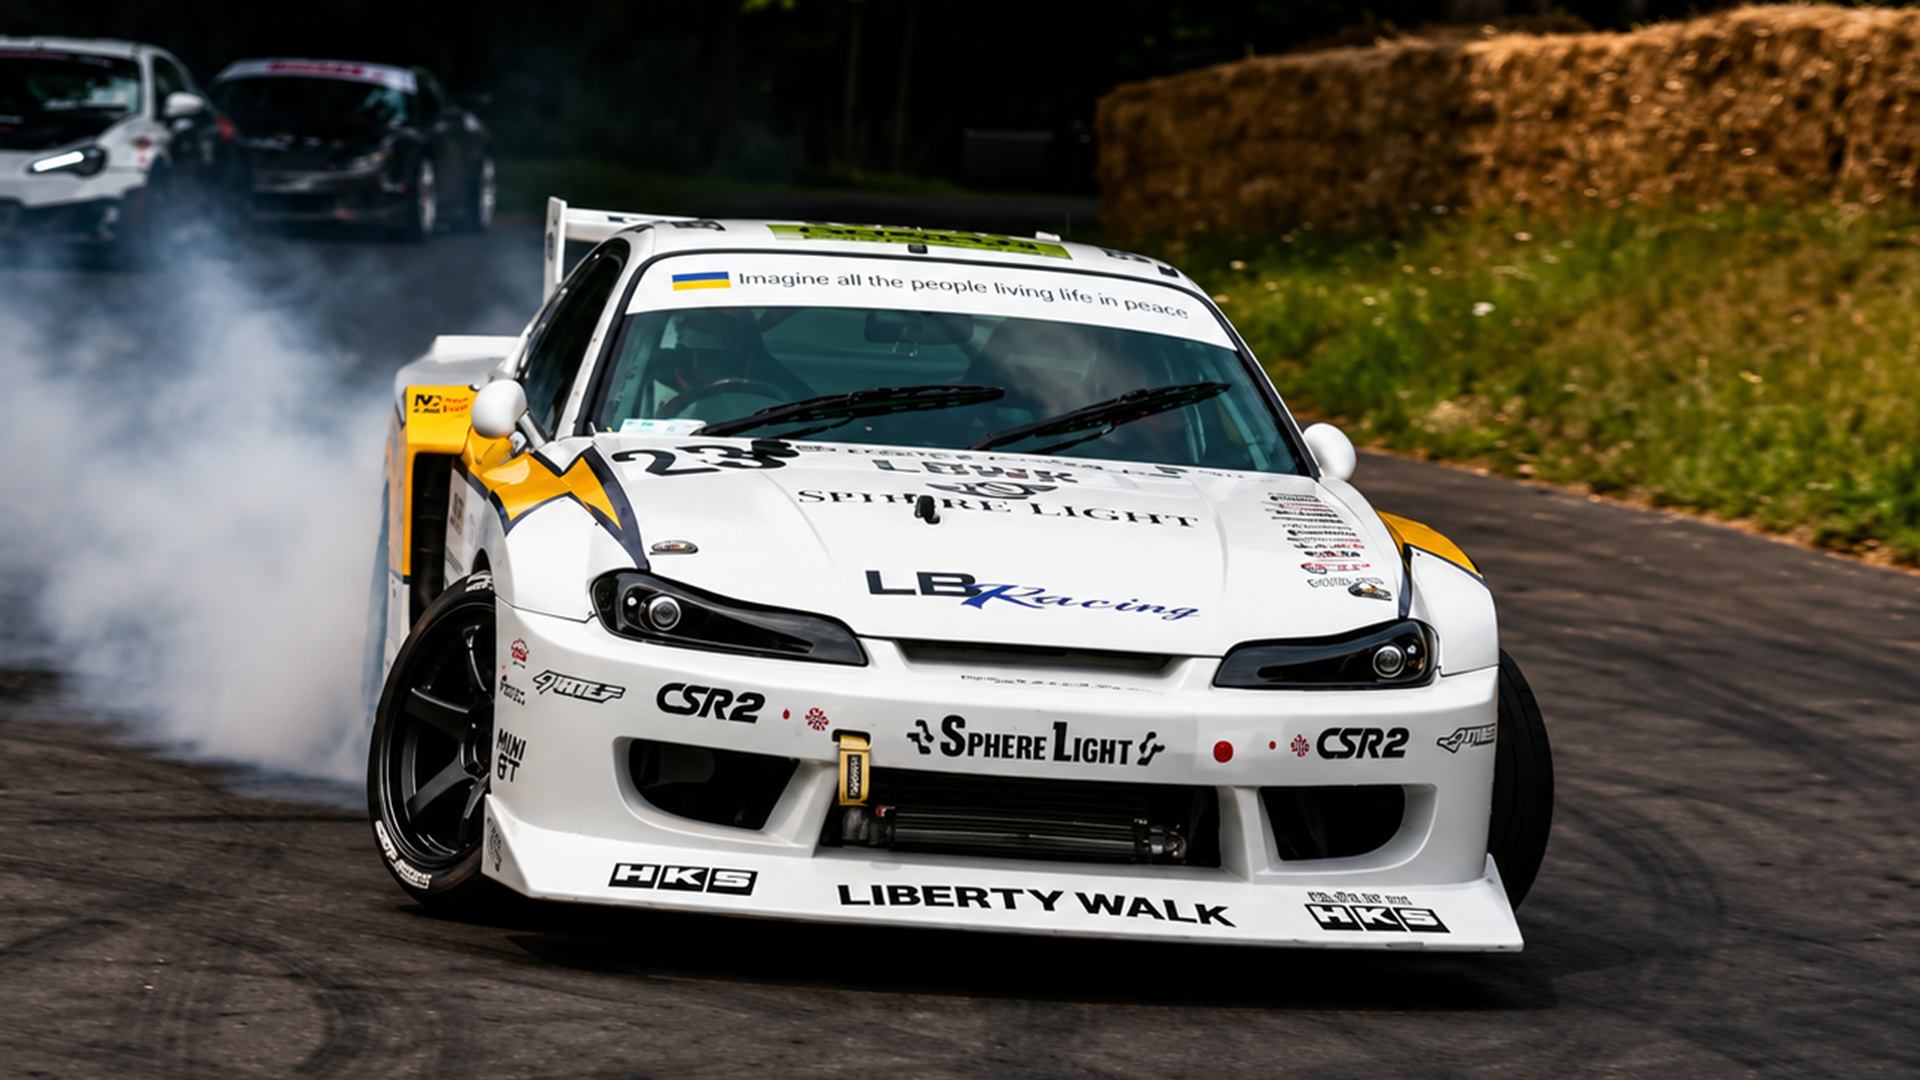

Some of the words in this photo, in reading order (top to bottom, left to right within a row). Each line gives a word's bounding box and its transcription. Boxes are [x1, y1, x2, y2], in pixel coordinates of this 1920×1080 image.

[739, 272, 829, 288] Imagine
[837, 273, 862, 287] all
[868, 274, 904, 289] the
[911, 278, 987, 295] people
[994, 281, 1054, 302] living
[1059, 287, 1093, 304] life
[1098, 292, 1119, 307] in
[1124, 299, 1189, 319] peace
[1031, 502, 1199, 528] LIGHT
[865, 570, 982, 597] LB
[960, 582, 1200, 621] Racing
[656, 682, 766, 724] CSR2
[496, 728, 527, 761] MINI
[940, 715, 1048, 761] SPHERE
[1052, 721, 1134, 766] LIGHT
[1316, 727, 1410, 760] CSR2
[497, 752, 520, 783] GT
[613, 864, 756, 891] HKS
[837, 884, 1064, 911] LIBERTY
[1074, 892, 1237, 928] WALK
[1306, 904, 1442, 928] HKS
